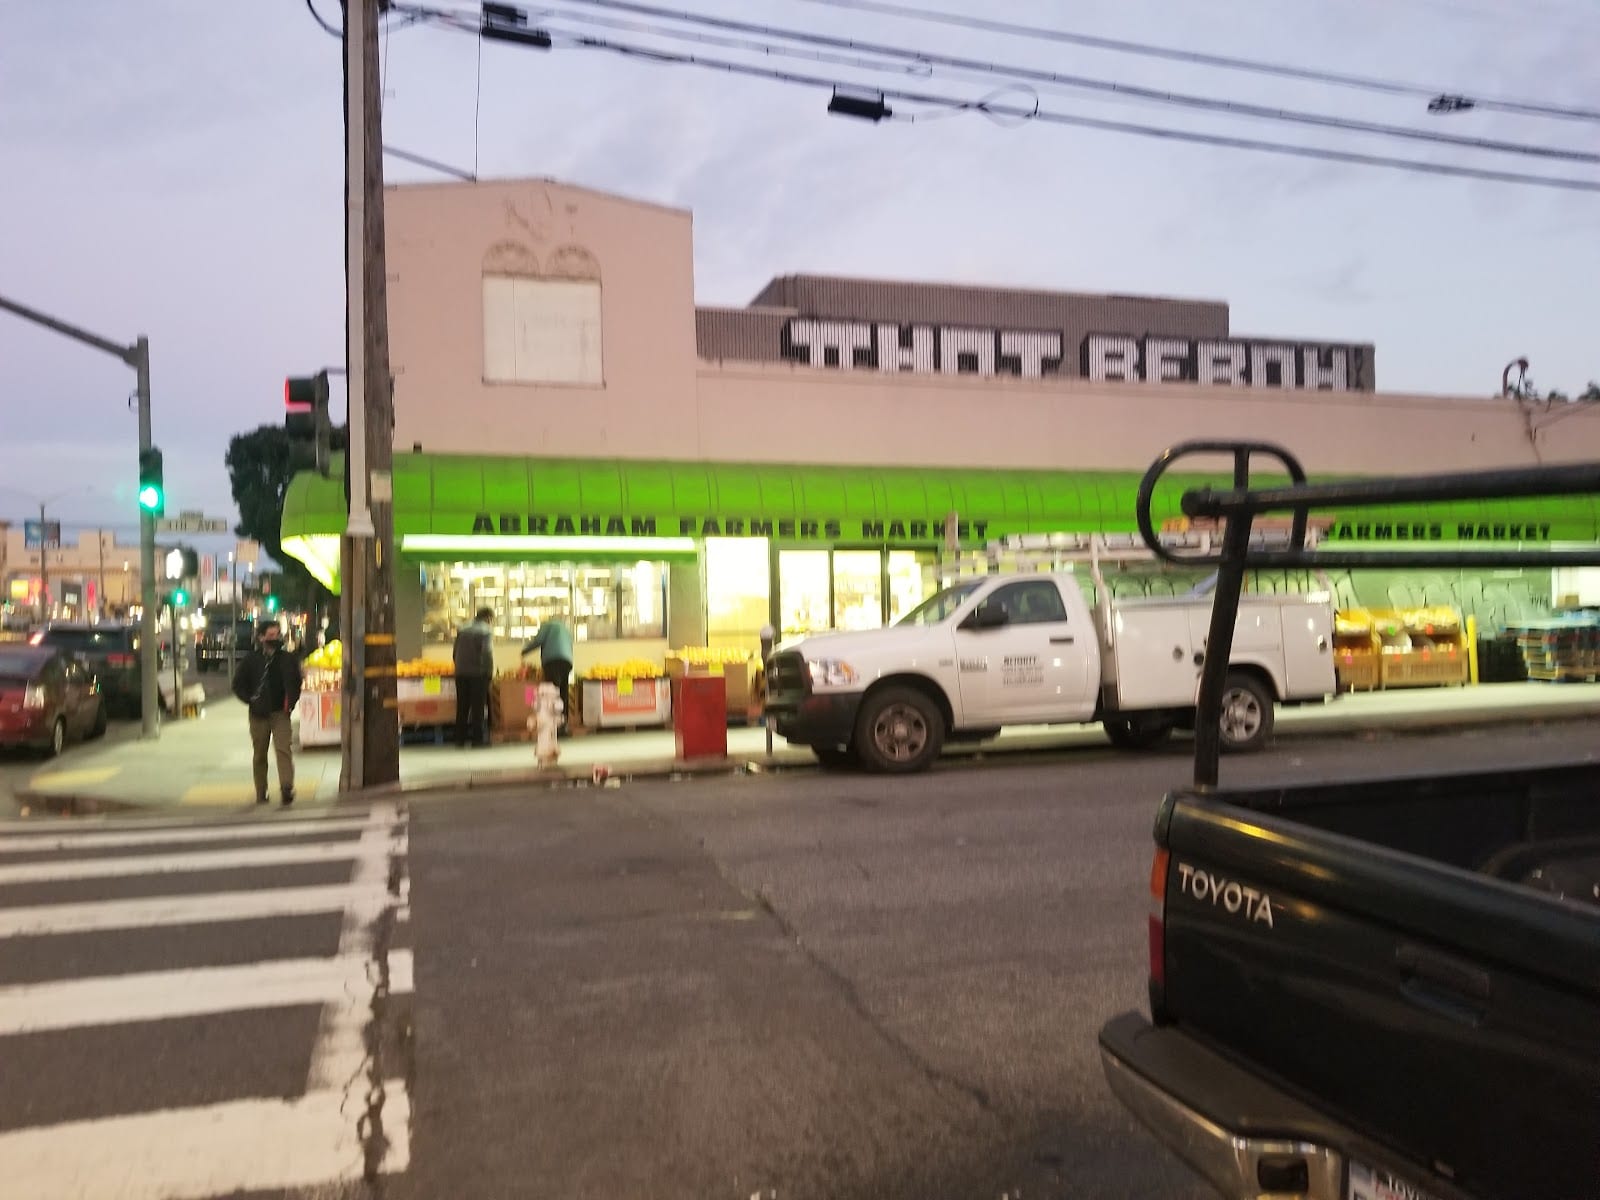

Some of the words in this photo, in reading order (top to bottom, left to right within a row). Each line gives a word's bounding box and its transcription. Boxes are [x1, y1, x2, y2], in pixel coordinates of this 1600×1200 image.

[472, 513, 656, 536] ABRAHAM
[679, 516, 840, 538] FARMERS
[861, 518, 988, 539] MARKET
[1328, 521, 1442, 540] ARMERS
[1457, 521, 1549, 540] MARKET
[1179, 862, 1273, 929] TOYOTA
